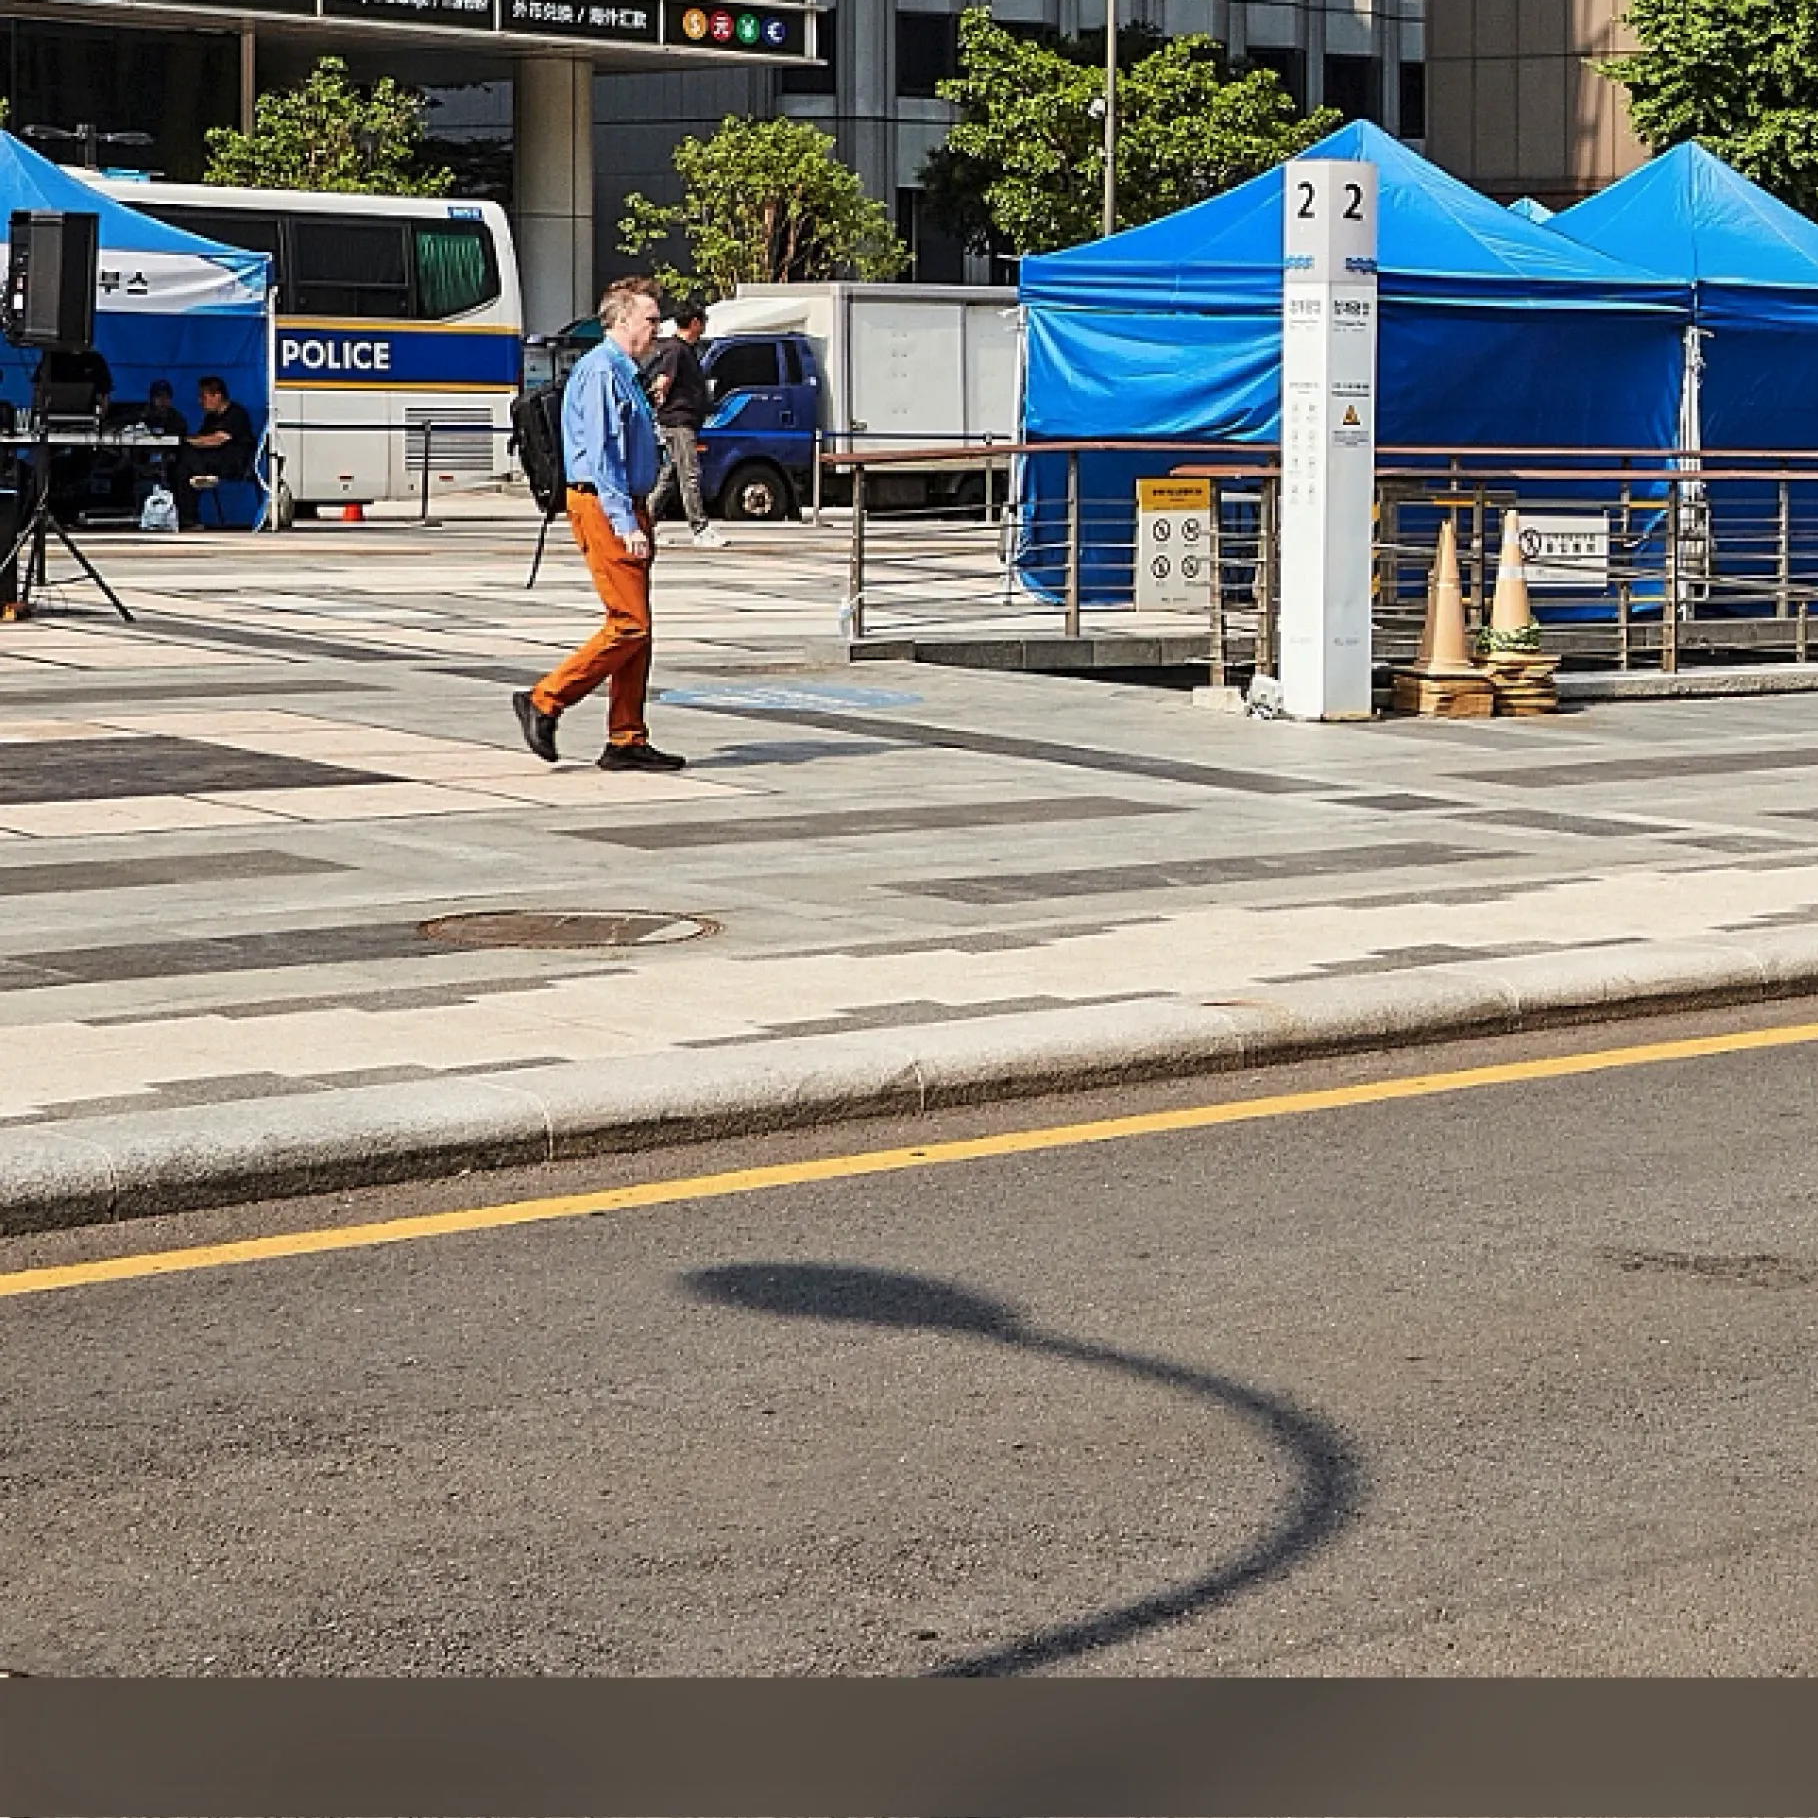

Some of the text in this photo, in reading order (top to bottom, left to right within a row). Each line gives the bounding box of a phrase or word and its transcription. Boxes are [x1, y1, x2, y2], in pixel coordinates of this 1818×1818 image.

[1297, 180, 1316, 219] 2
[1342, 182, 1364, 221] 2
[281, 339, 392, 370] POLICE
